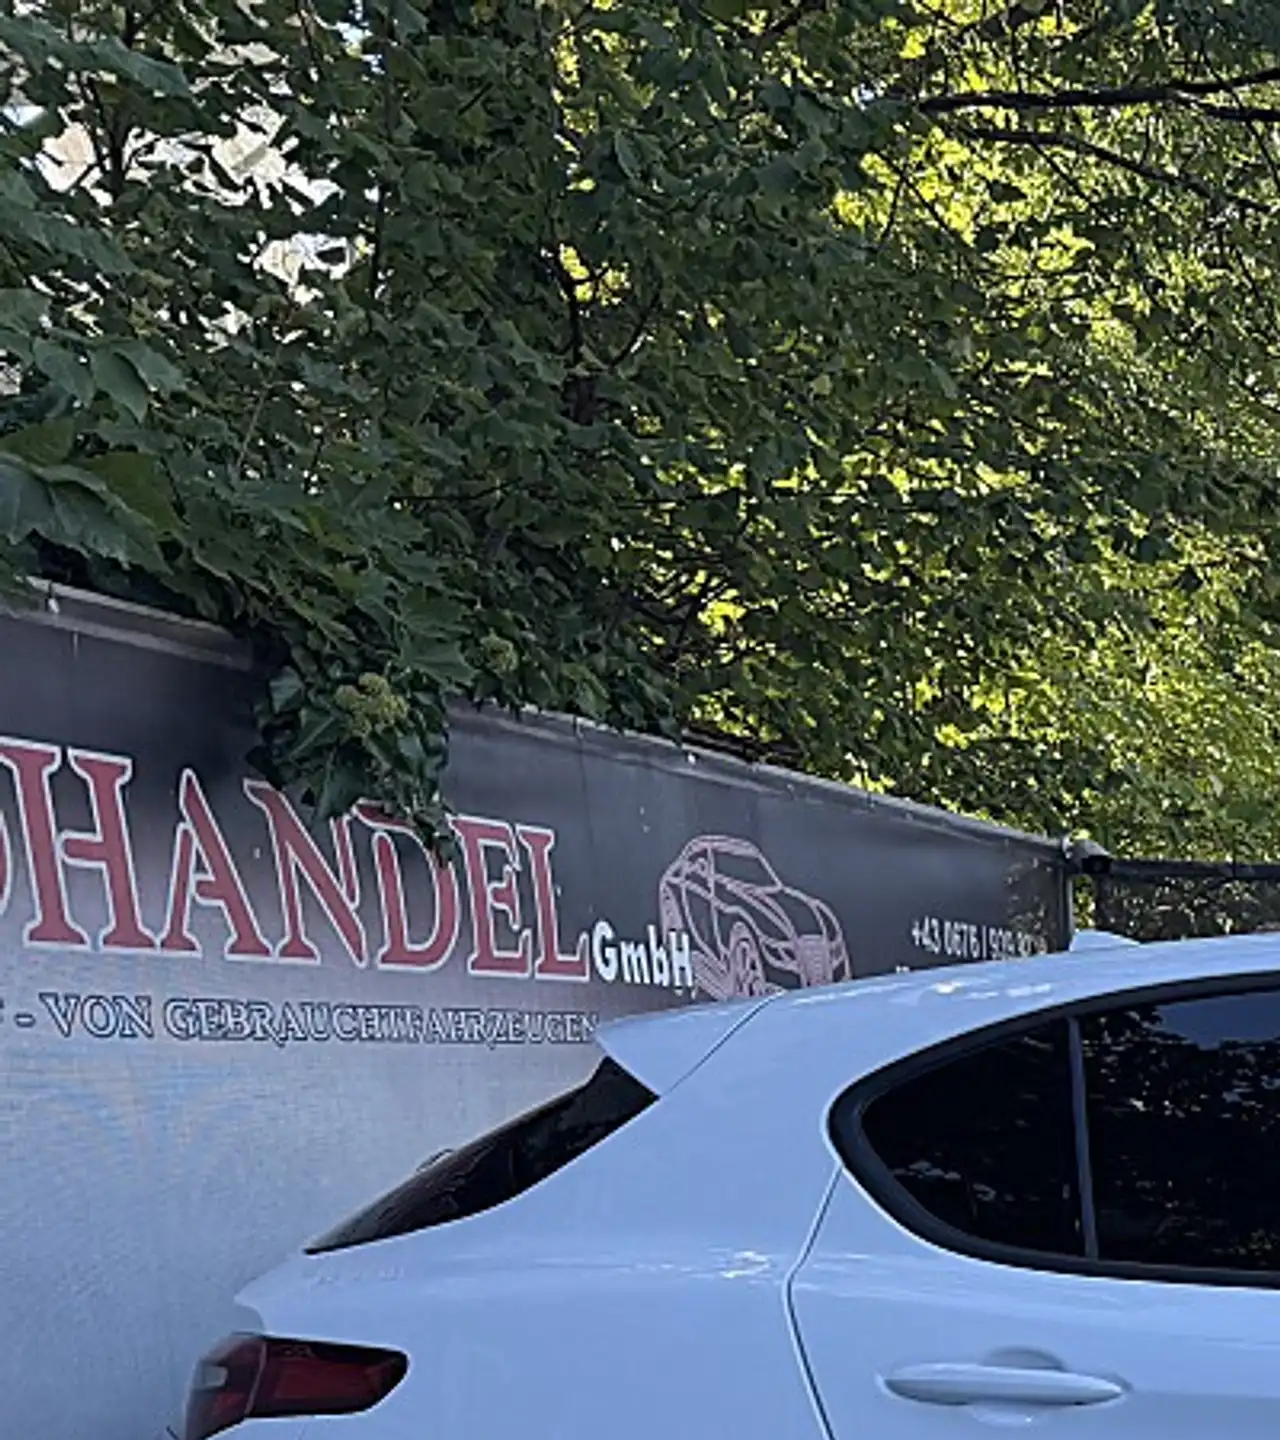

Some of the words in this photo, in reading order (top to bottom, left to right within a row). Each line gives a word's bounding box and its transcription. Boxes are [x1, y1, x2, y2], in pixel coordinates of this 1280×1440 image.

[0, 736, 590, 982] HANDEL
[590, 920, 694, 987] GmbH
[38, 992, 155, 1038] VON
